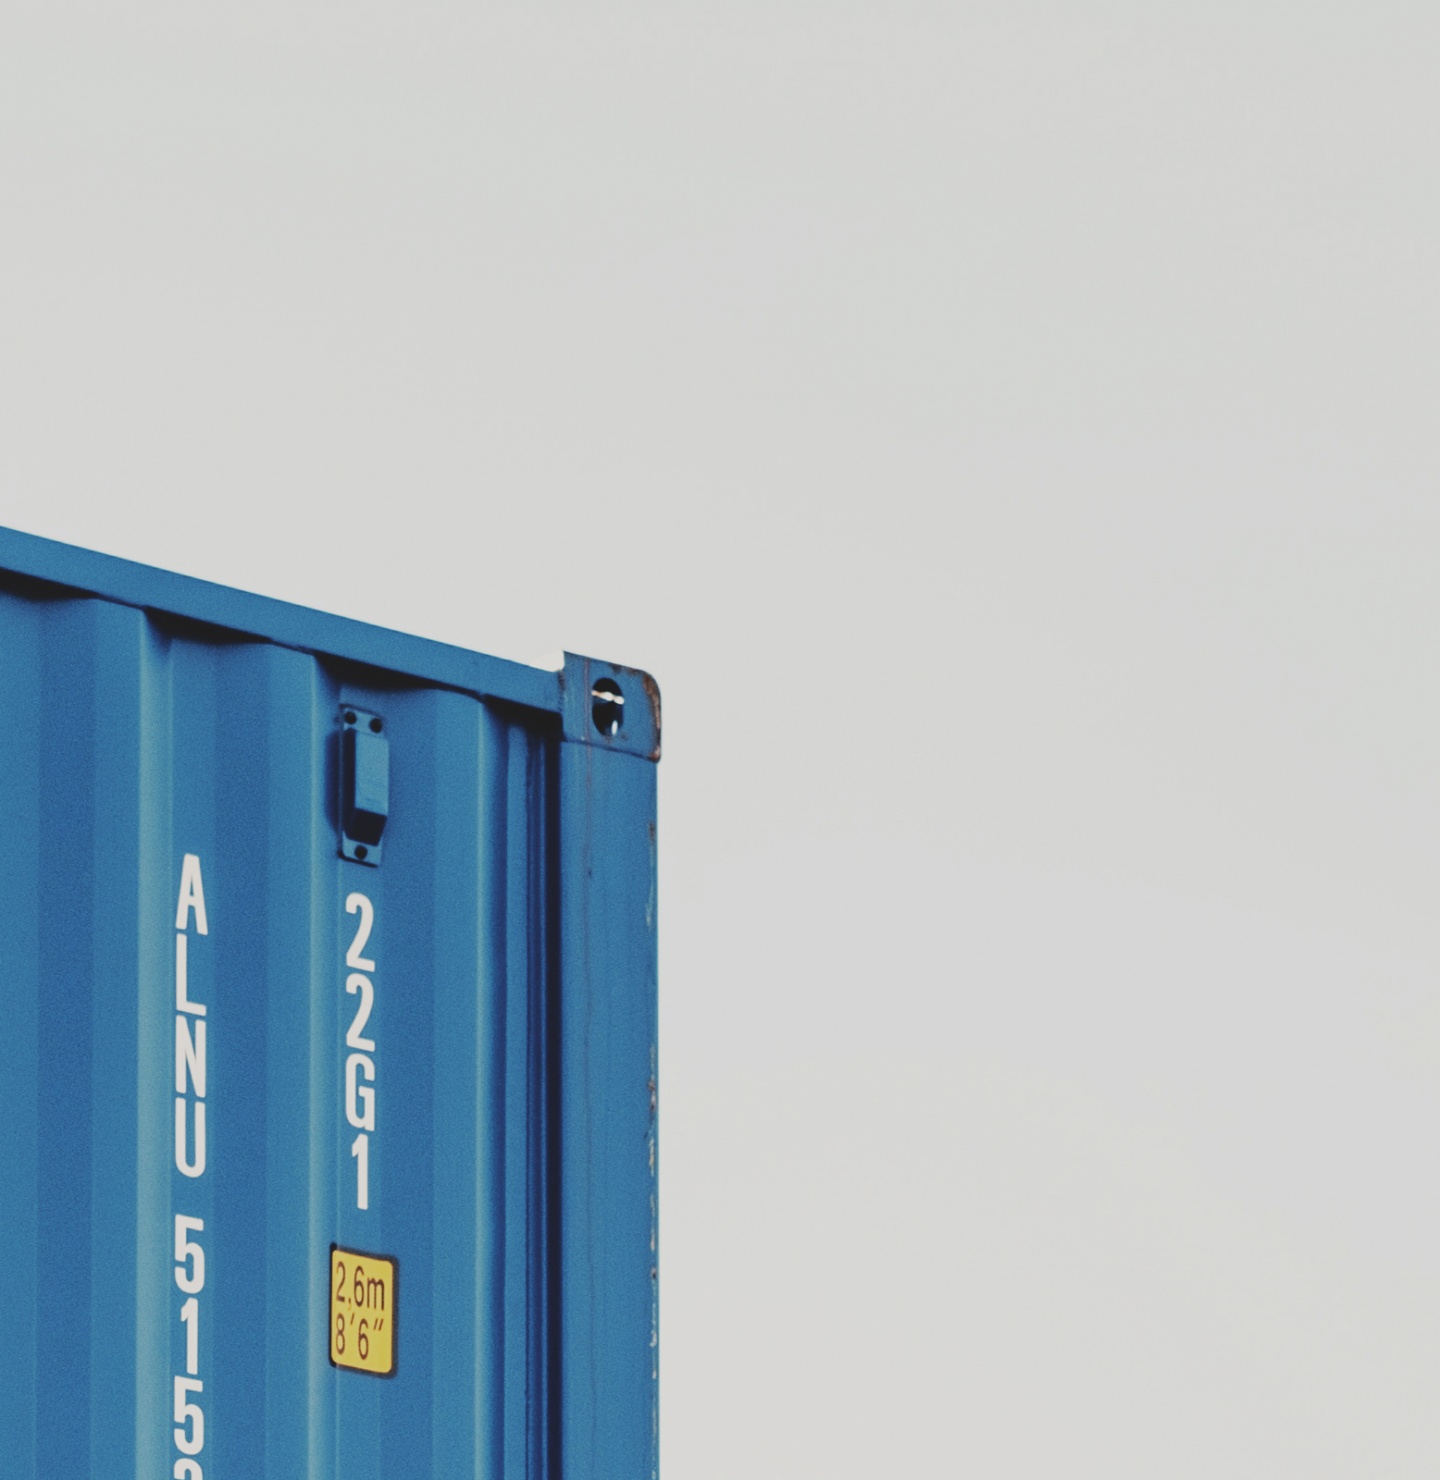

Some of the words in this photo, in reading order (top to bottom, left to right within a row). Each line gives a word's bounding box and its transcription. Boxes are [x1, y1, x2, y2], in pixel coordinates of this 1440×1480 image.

[174, 852, 209, 1179] ALNU
[344, 891, 376, 1211] 22G1
[335, 1260, 386, 1312] 2,6m
